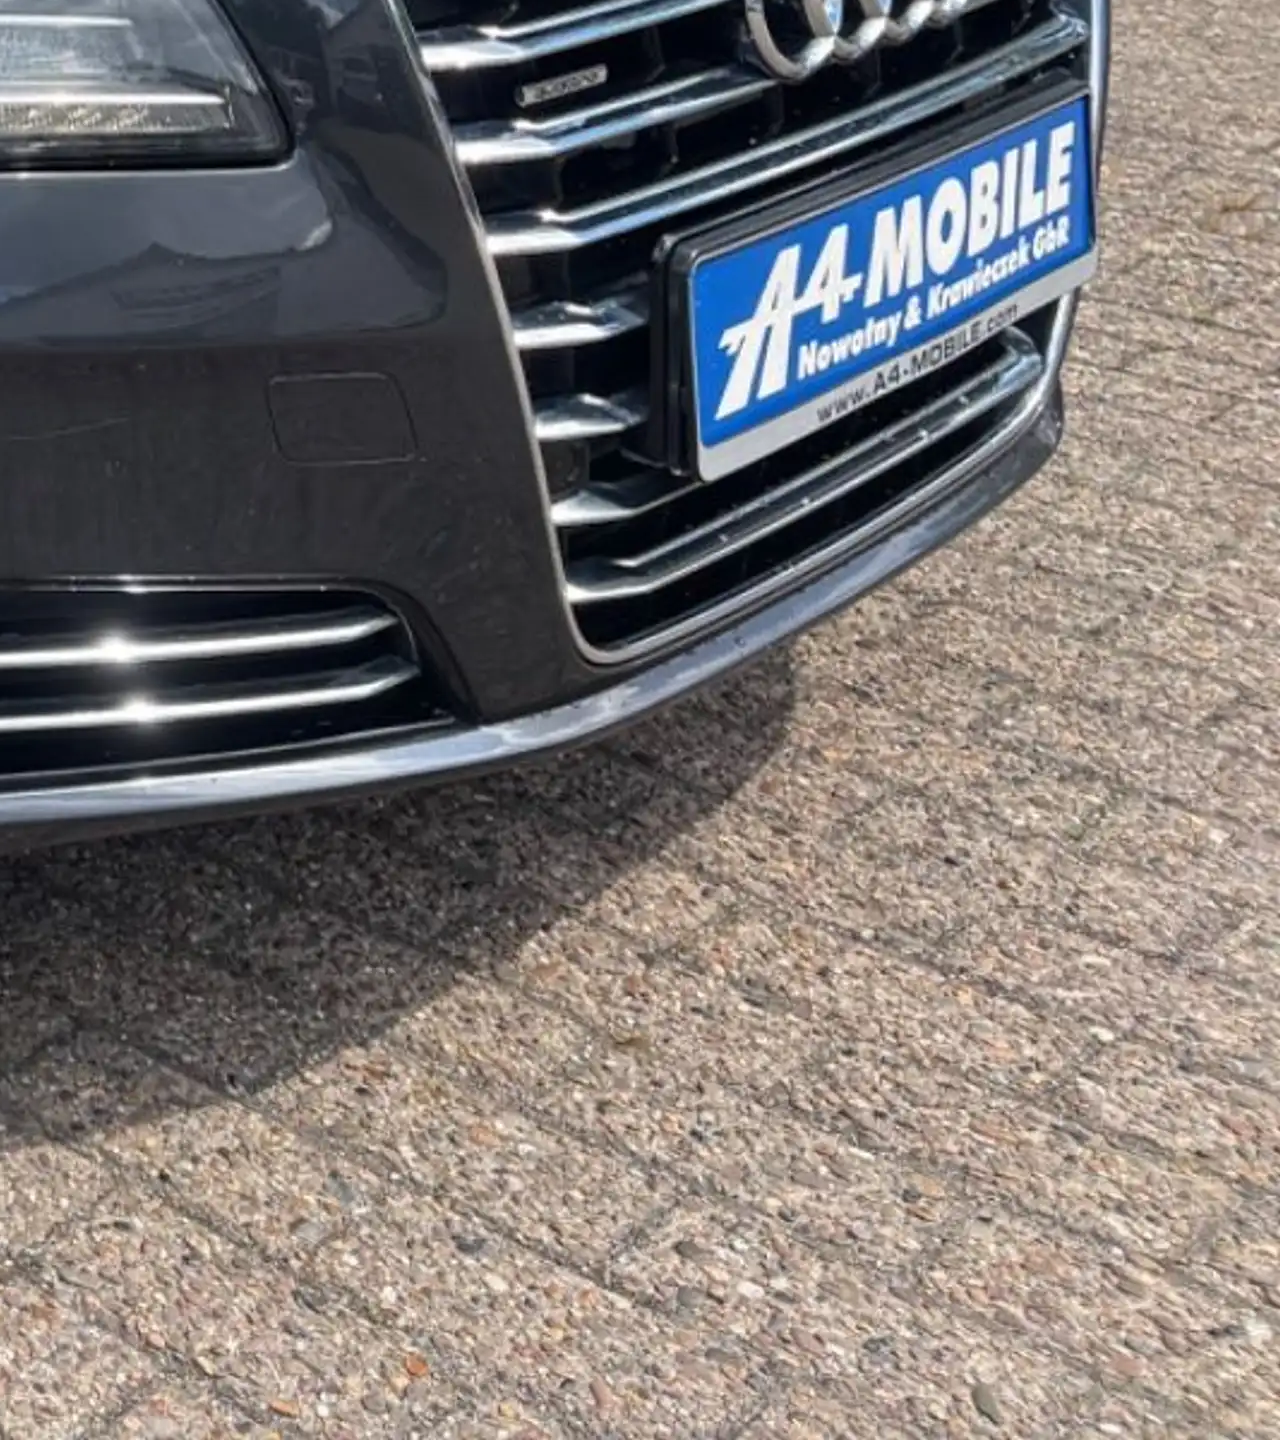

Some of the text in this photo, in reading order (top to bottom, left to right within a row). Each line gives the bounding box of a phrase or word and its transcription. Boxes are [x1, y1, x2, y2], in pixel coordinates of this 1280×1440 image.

[714, 123, 1075, 420] A4-MOBILE
[903, 294, 921, 330] &
[1032, 215, 1070, 260] GbR
